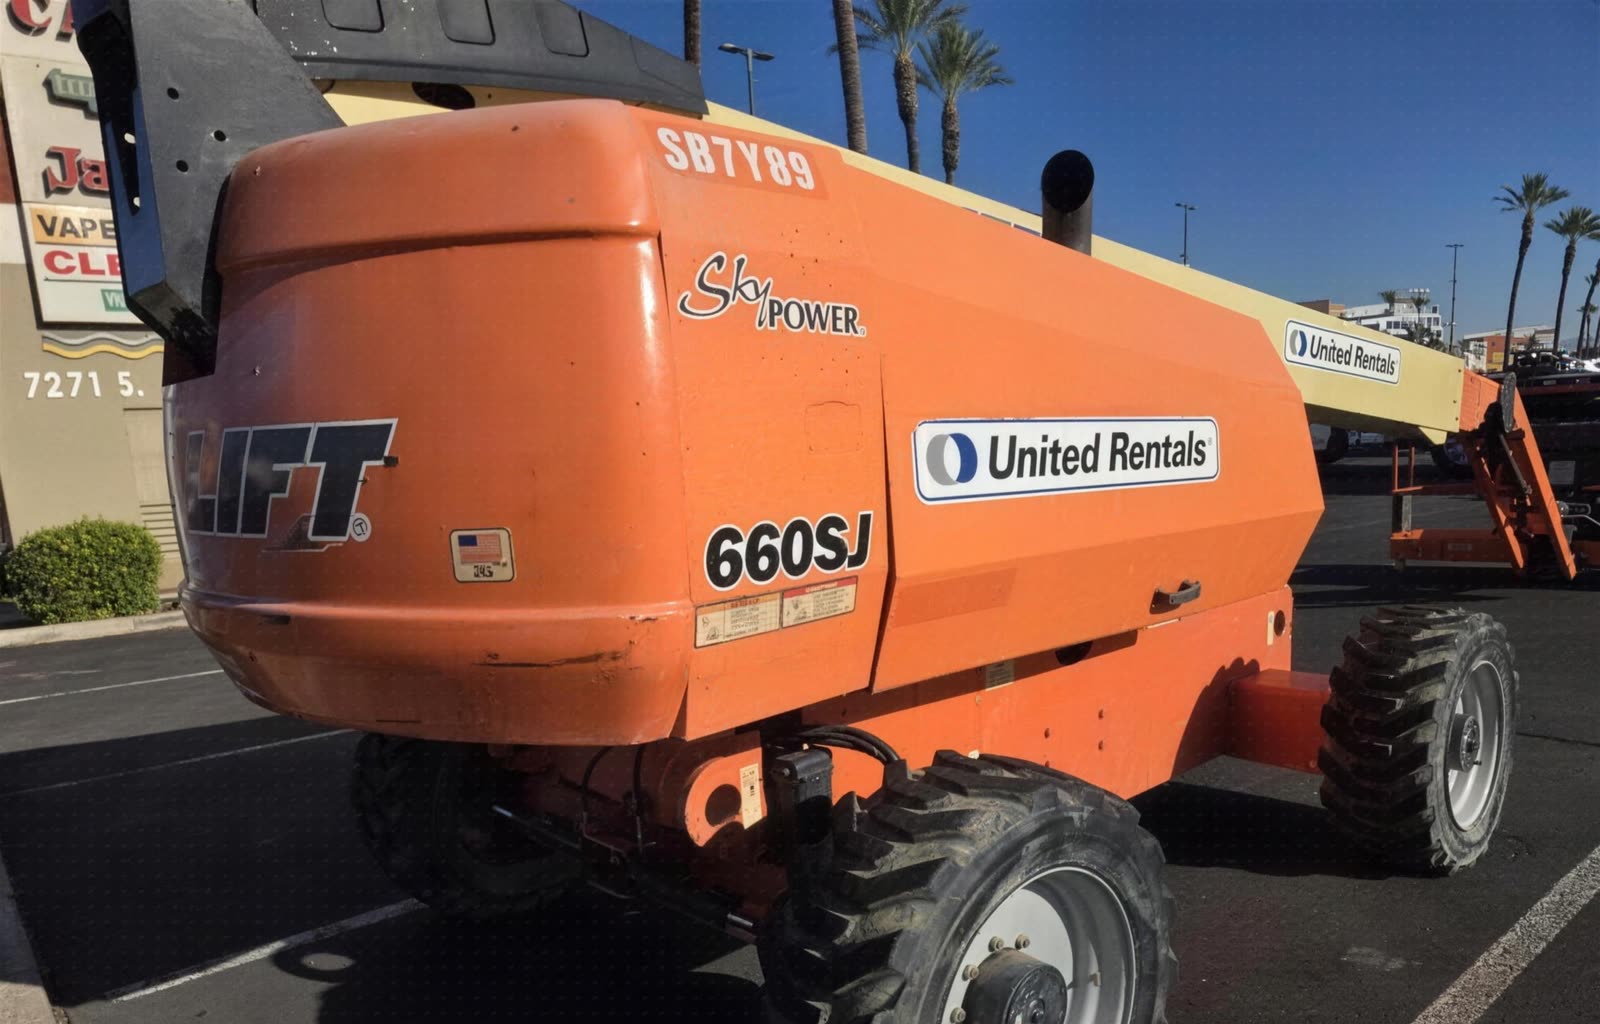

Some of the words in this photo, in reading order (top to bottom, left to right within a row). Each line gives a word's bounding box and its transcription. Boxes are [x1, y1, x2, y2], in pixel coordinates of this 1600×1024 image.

[657, 127, 815, 190] SB7Y89
[36, 214, 116, 240] VAPE
[678, 252, 773, 327] Sky
[768, 299, 859, 335] POWER
[1310, 334, 1353, 366] United
[1354, 345, 1396, 376] Rentals
[23, 371, 101, 398] 7271
[988, 433, 1101, 480] United
[1108, 430, 1207, 472] Rentals
[704, 510, 873, 591] 660SJ
